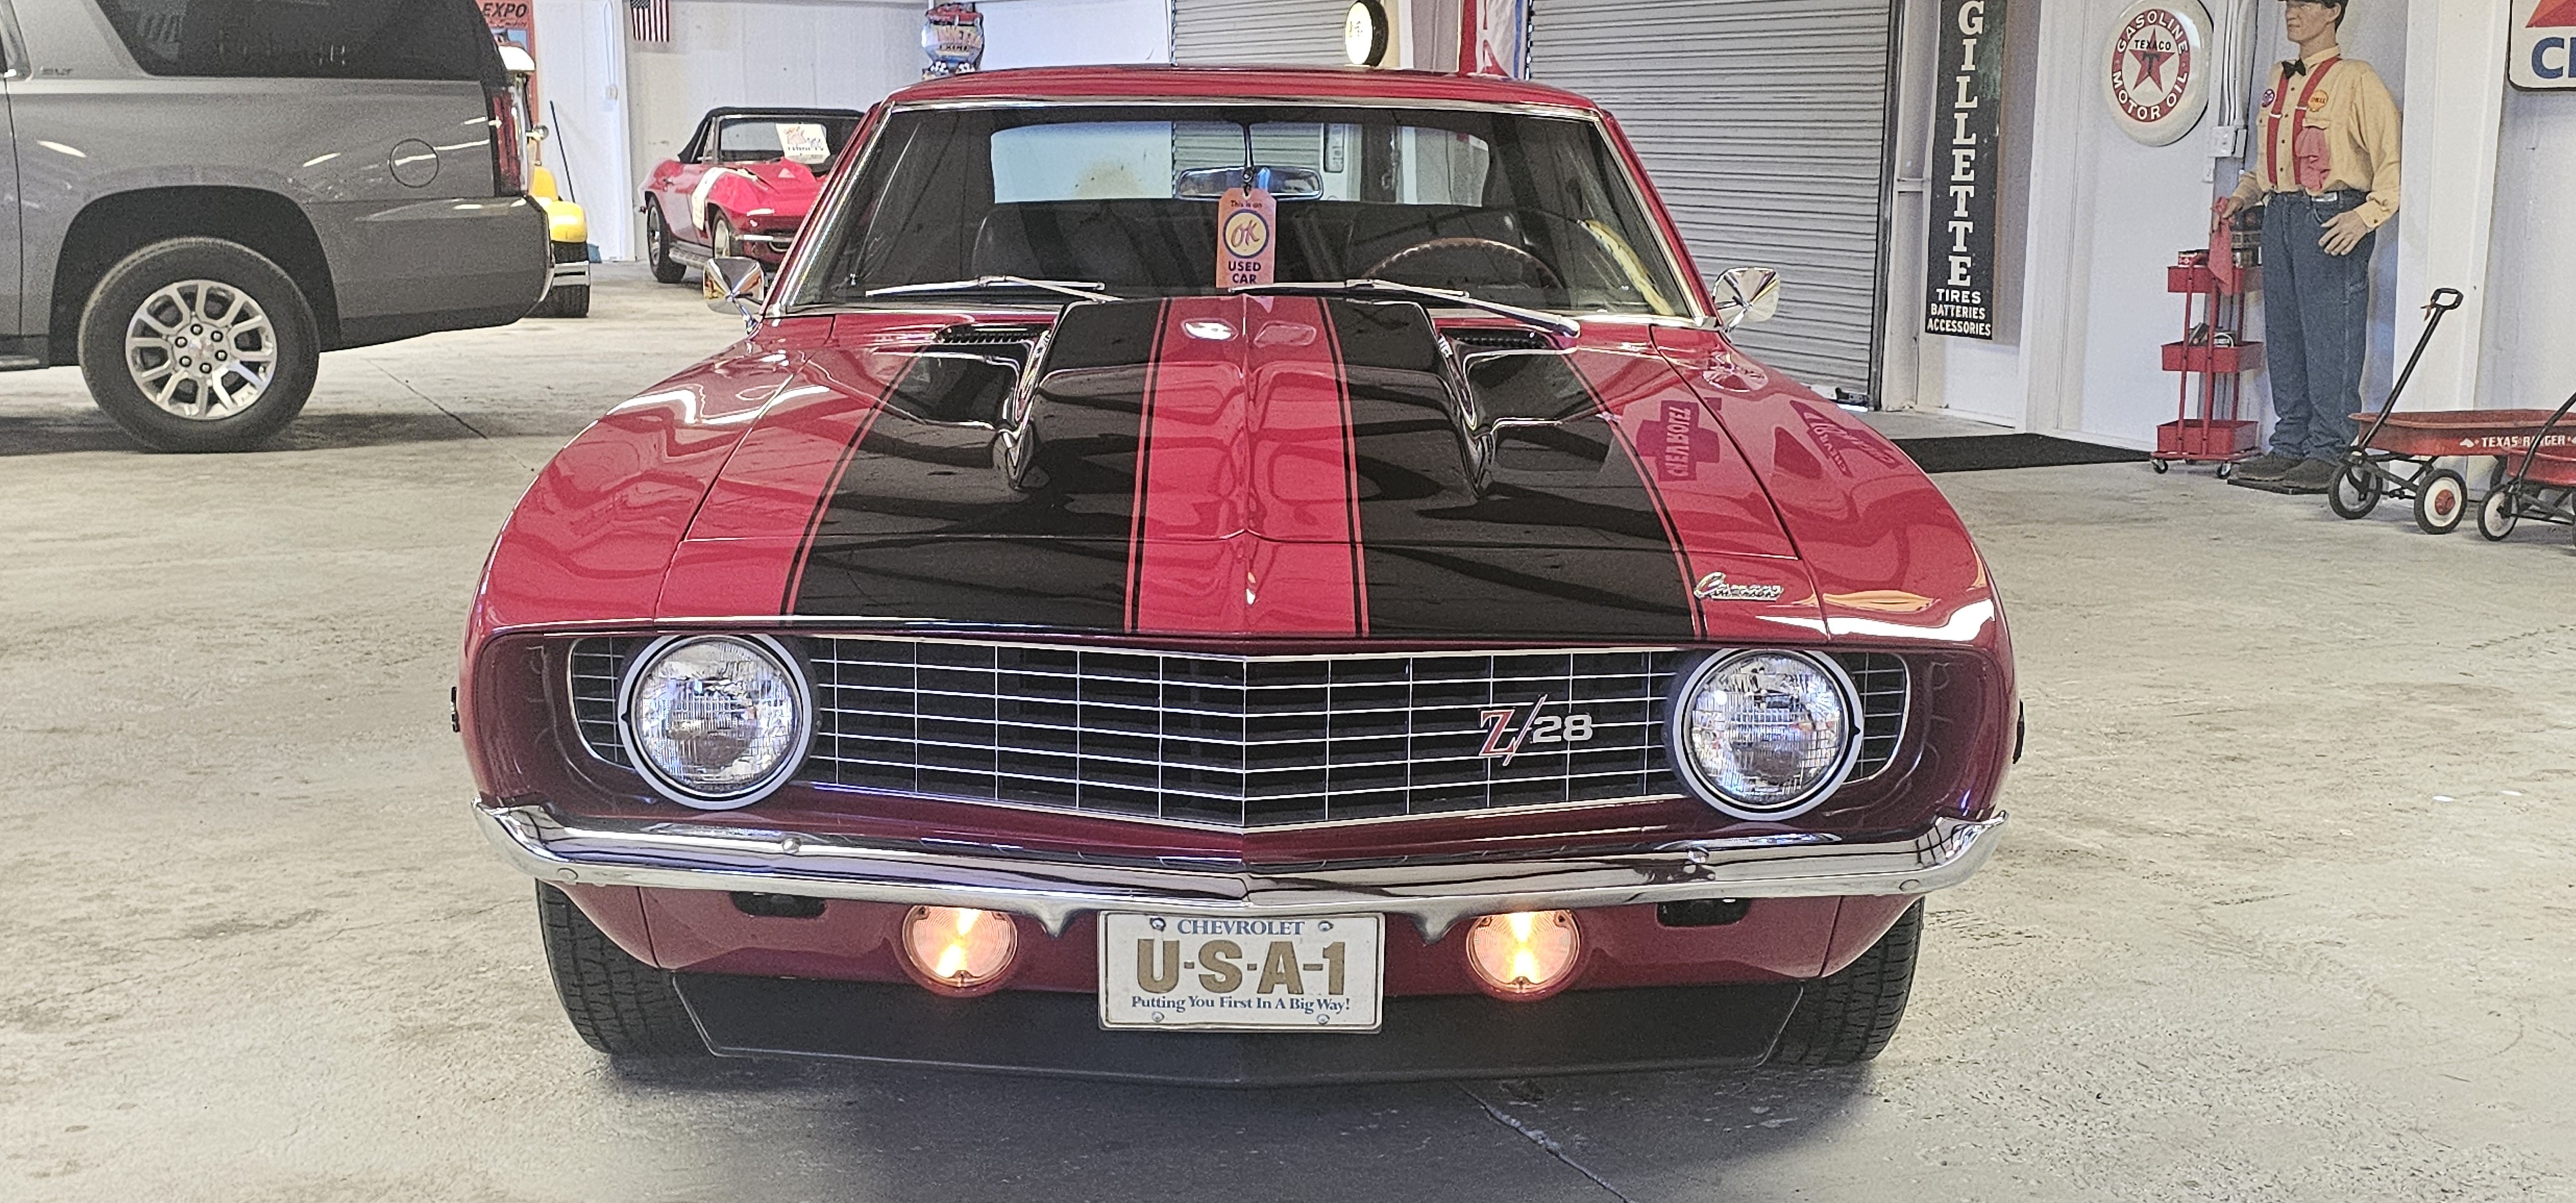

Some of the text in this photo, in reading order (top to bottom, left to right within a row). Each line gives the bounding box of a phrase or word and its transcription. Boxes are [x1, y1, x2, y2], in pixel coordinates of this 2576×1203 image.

[482, 3, 527, 18] EXPO
[2117, 11, 2188, 54] GASOLINE
[2134, 40, 2171, 51] TEXACO
[2113, 71, 2187, 120] MOTOR OIL
[1947, 1, 1984, 286] GILLETTE
[1231, 220, 1260, 248] OK
[1228, 261, 1261, 272] USED
[1232, 273, 1256, 283] CAR
[1936, 289, 1981, 304] TIRES
[1931, 303, 1985, 320] BATTERIES
[1927, 318, 1991, 336] ACCESSORIES
[2481, 435, 2565, 448] TEXAS RGER
[1479, 694, 1593, 766] Z/28
[1177, 919, 1305, 934] CHEVROLET
[1132, 996, 1350, 1014] Putting You First In A Big Way!
